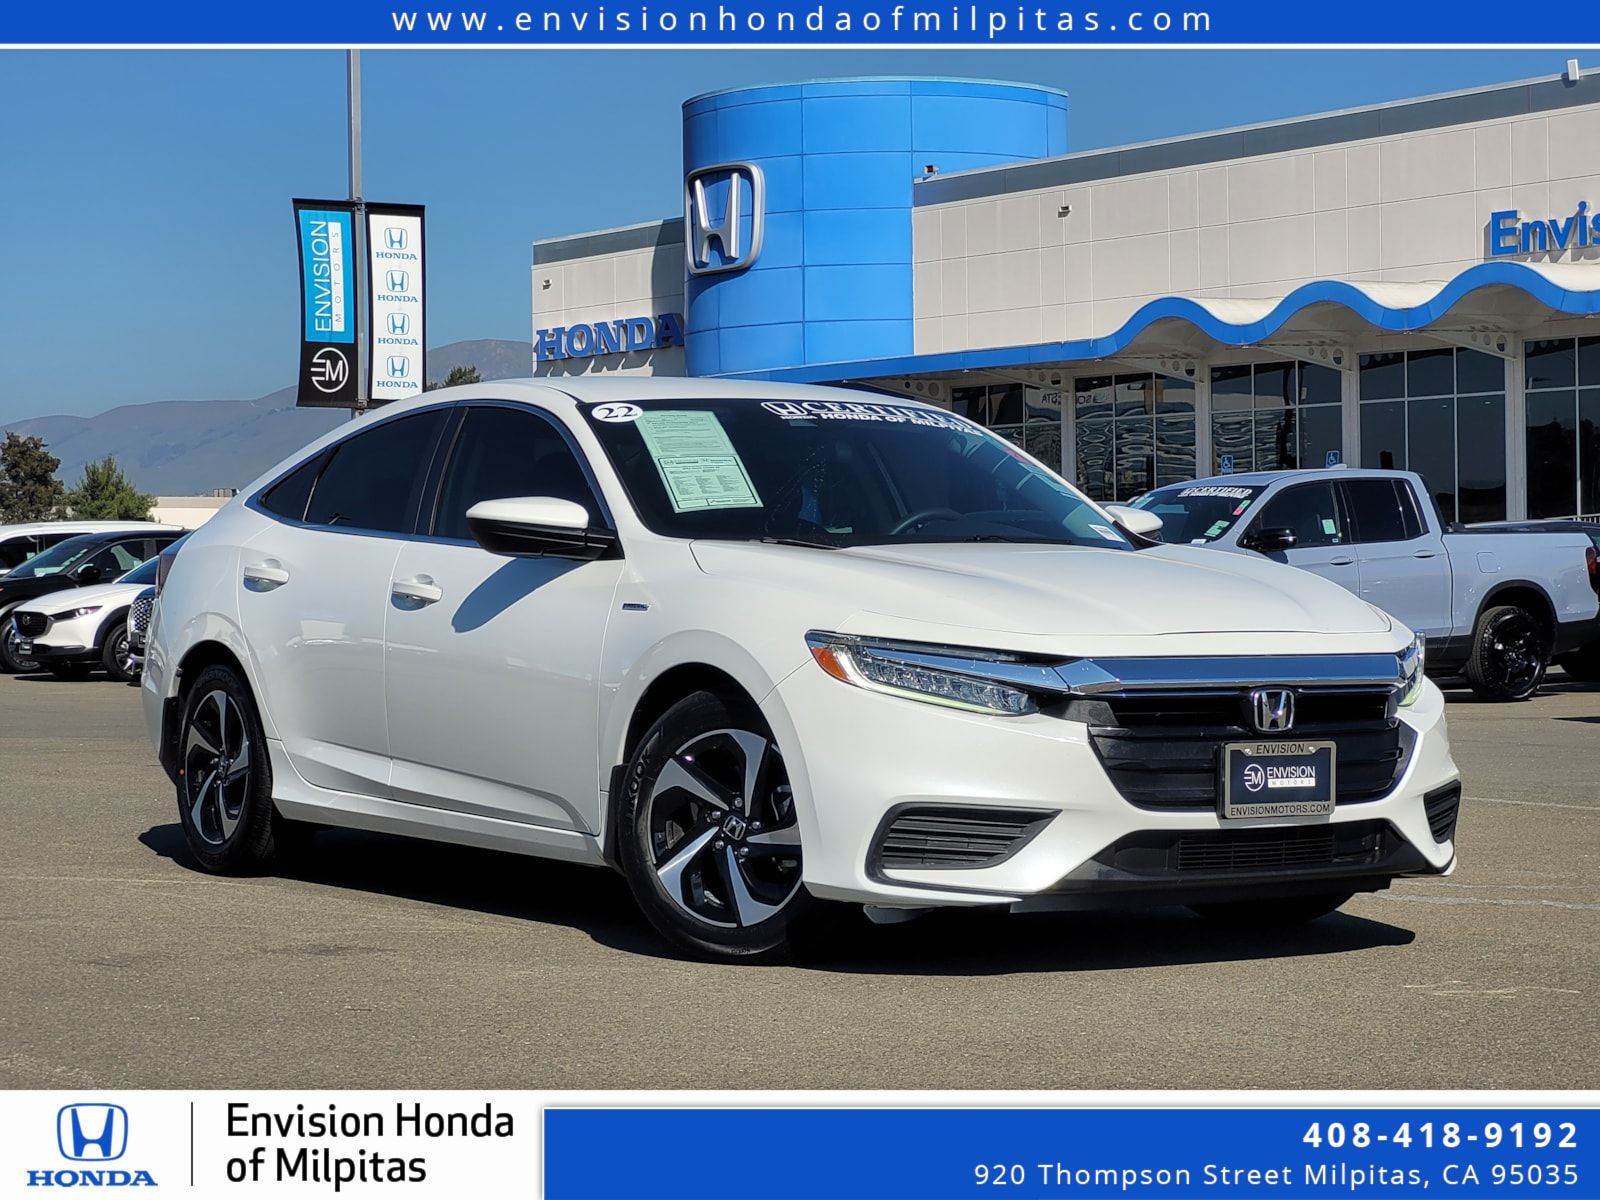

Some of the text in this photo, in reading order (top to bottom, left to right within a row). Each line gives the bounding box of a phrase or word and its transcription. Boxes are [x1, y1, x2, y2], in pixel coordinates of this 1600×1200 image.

[376, 251, 418, 261] HONDA
[309, 220, 332, 332] ENVISION
[332, 231, 342, 323] MOTORS
[377, 294, 418, 303] HONDA
[377, 337, 419, 346] HONDA
[536, 313, 685, 362] HONDA
[376, 380, 418, 389] HONDA
[597, 406, 638, 419] 22
[801, 401, 973, 430] CERTIFIED
[820, 413, 883, 421] HONDA
[911, 418, 984, 437] MILPITAS
[1256, 743, 1305, 755] ENVISION
[1266, 766, 1316, 779] ENVISION
[1230, 804, 1330, 816] ENVISIONMOTORS.COM
